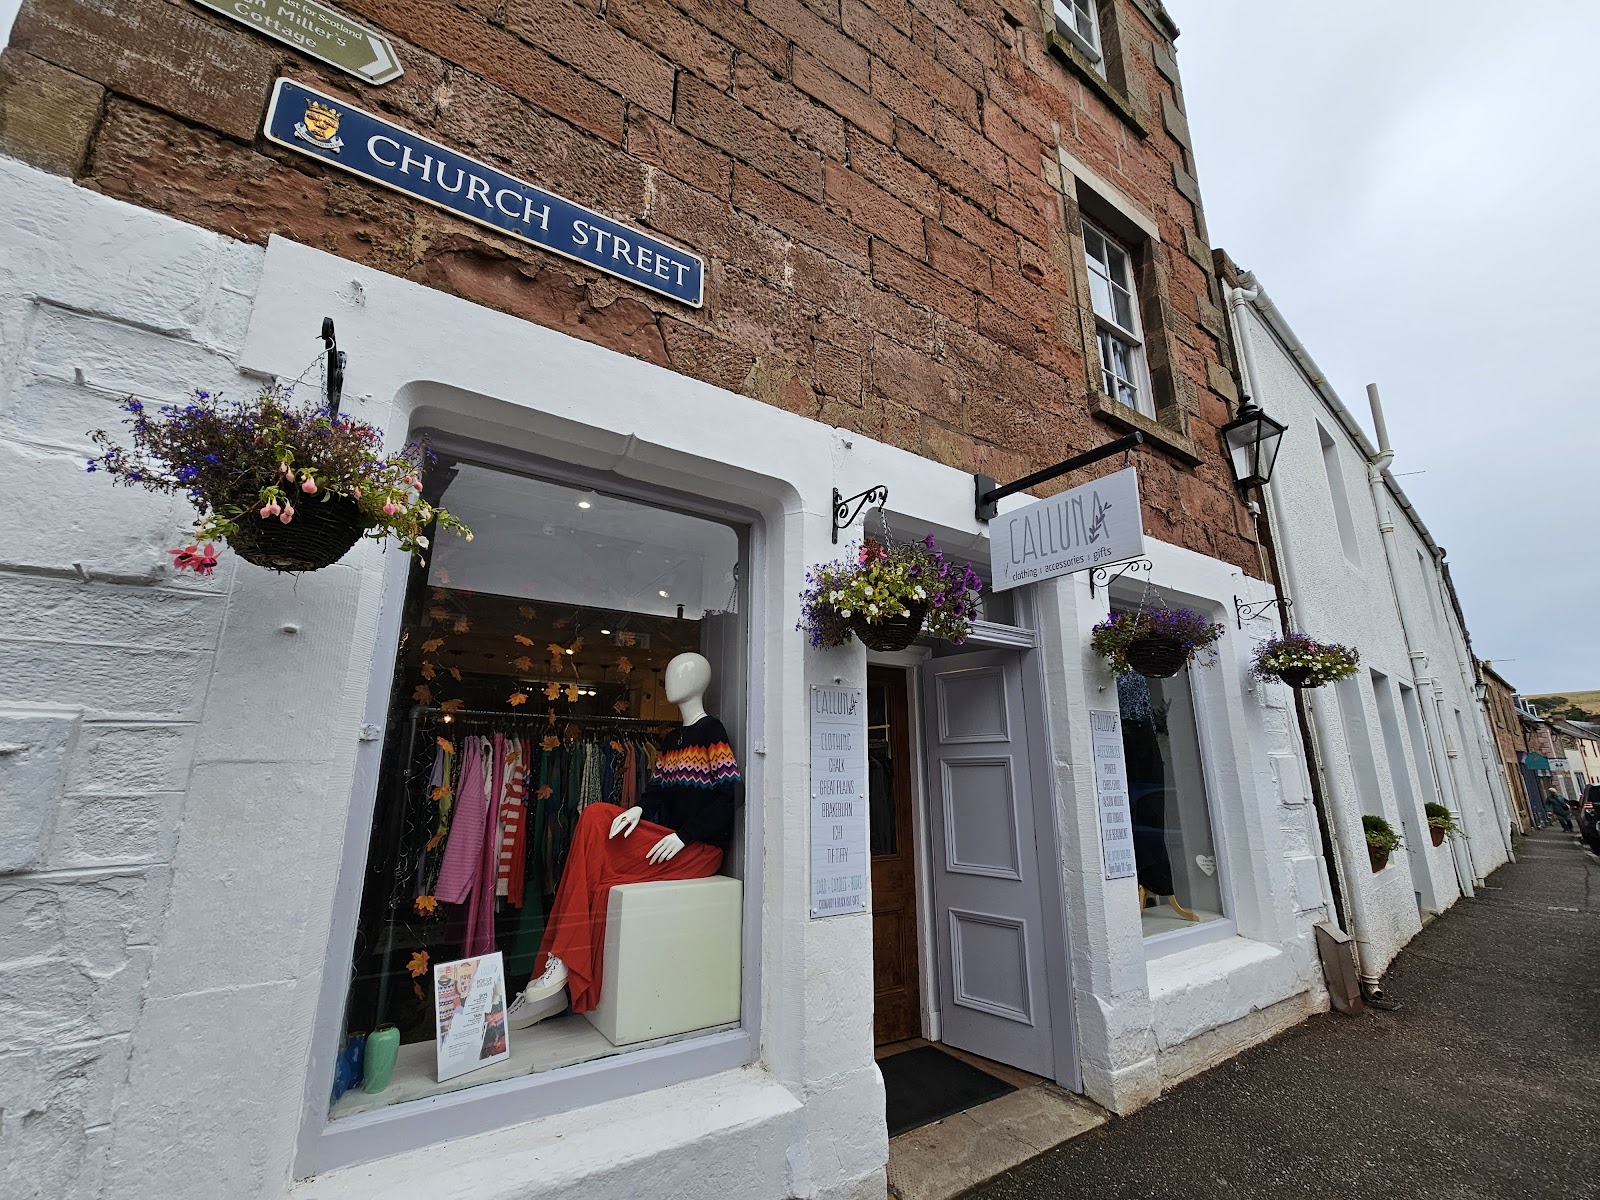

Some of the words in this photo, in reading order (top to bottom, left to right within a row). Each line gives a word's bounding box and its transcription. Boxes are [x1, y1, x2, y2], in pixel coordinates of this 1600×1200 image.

[234, 2, 316, 47] Cottage
[277, 6, 346, 46] Miller's
[302, 5, 317, 16] for
[318, 13, 362, 40] Scotland
[367, 134, 550, 232] CHURCH
[572, 220, 690, 286] STREET
[1009, 490, 1110, 564] CALLUNA
[1012, 567, 1038, 582] clothing
[1045, 554, 1084, 573] accessories
[1092, 547, 1112, 562] gifts
[816, 690, 857, 715] CALLUNA
[821, 732, 852, 751] CLOTHING
[828, 758, 845, 772] CHALK
